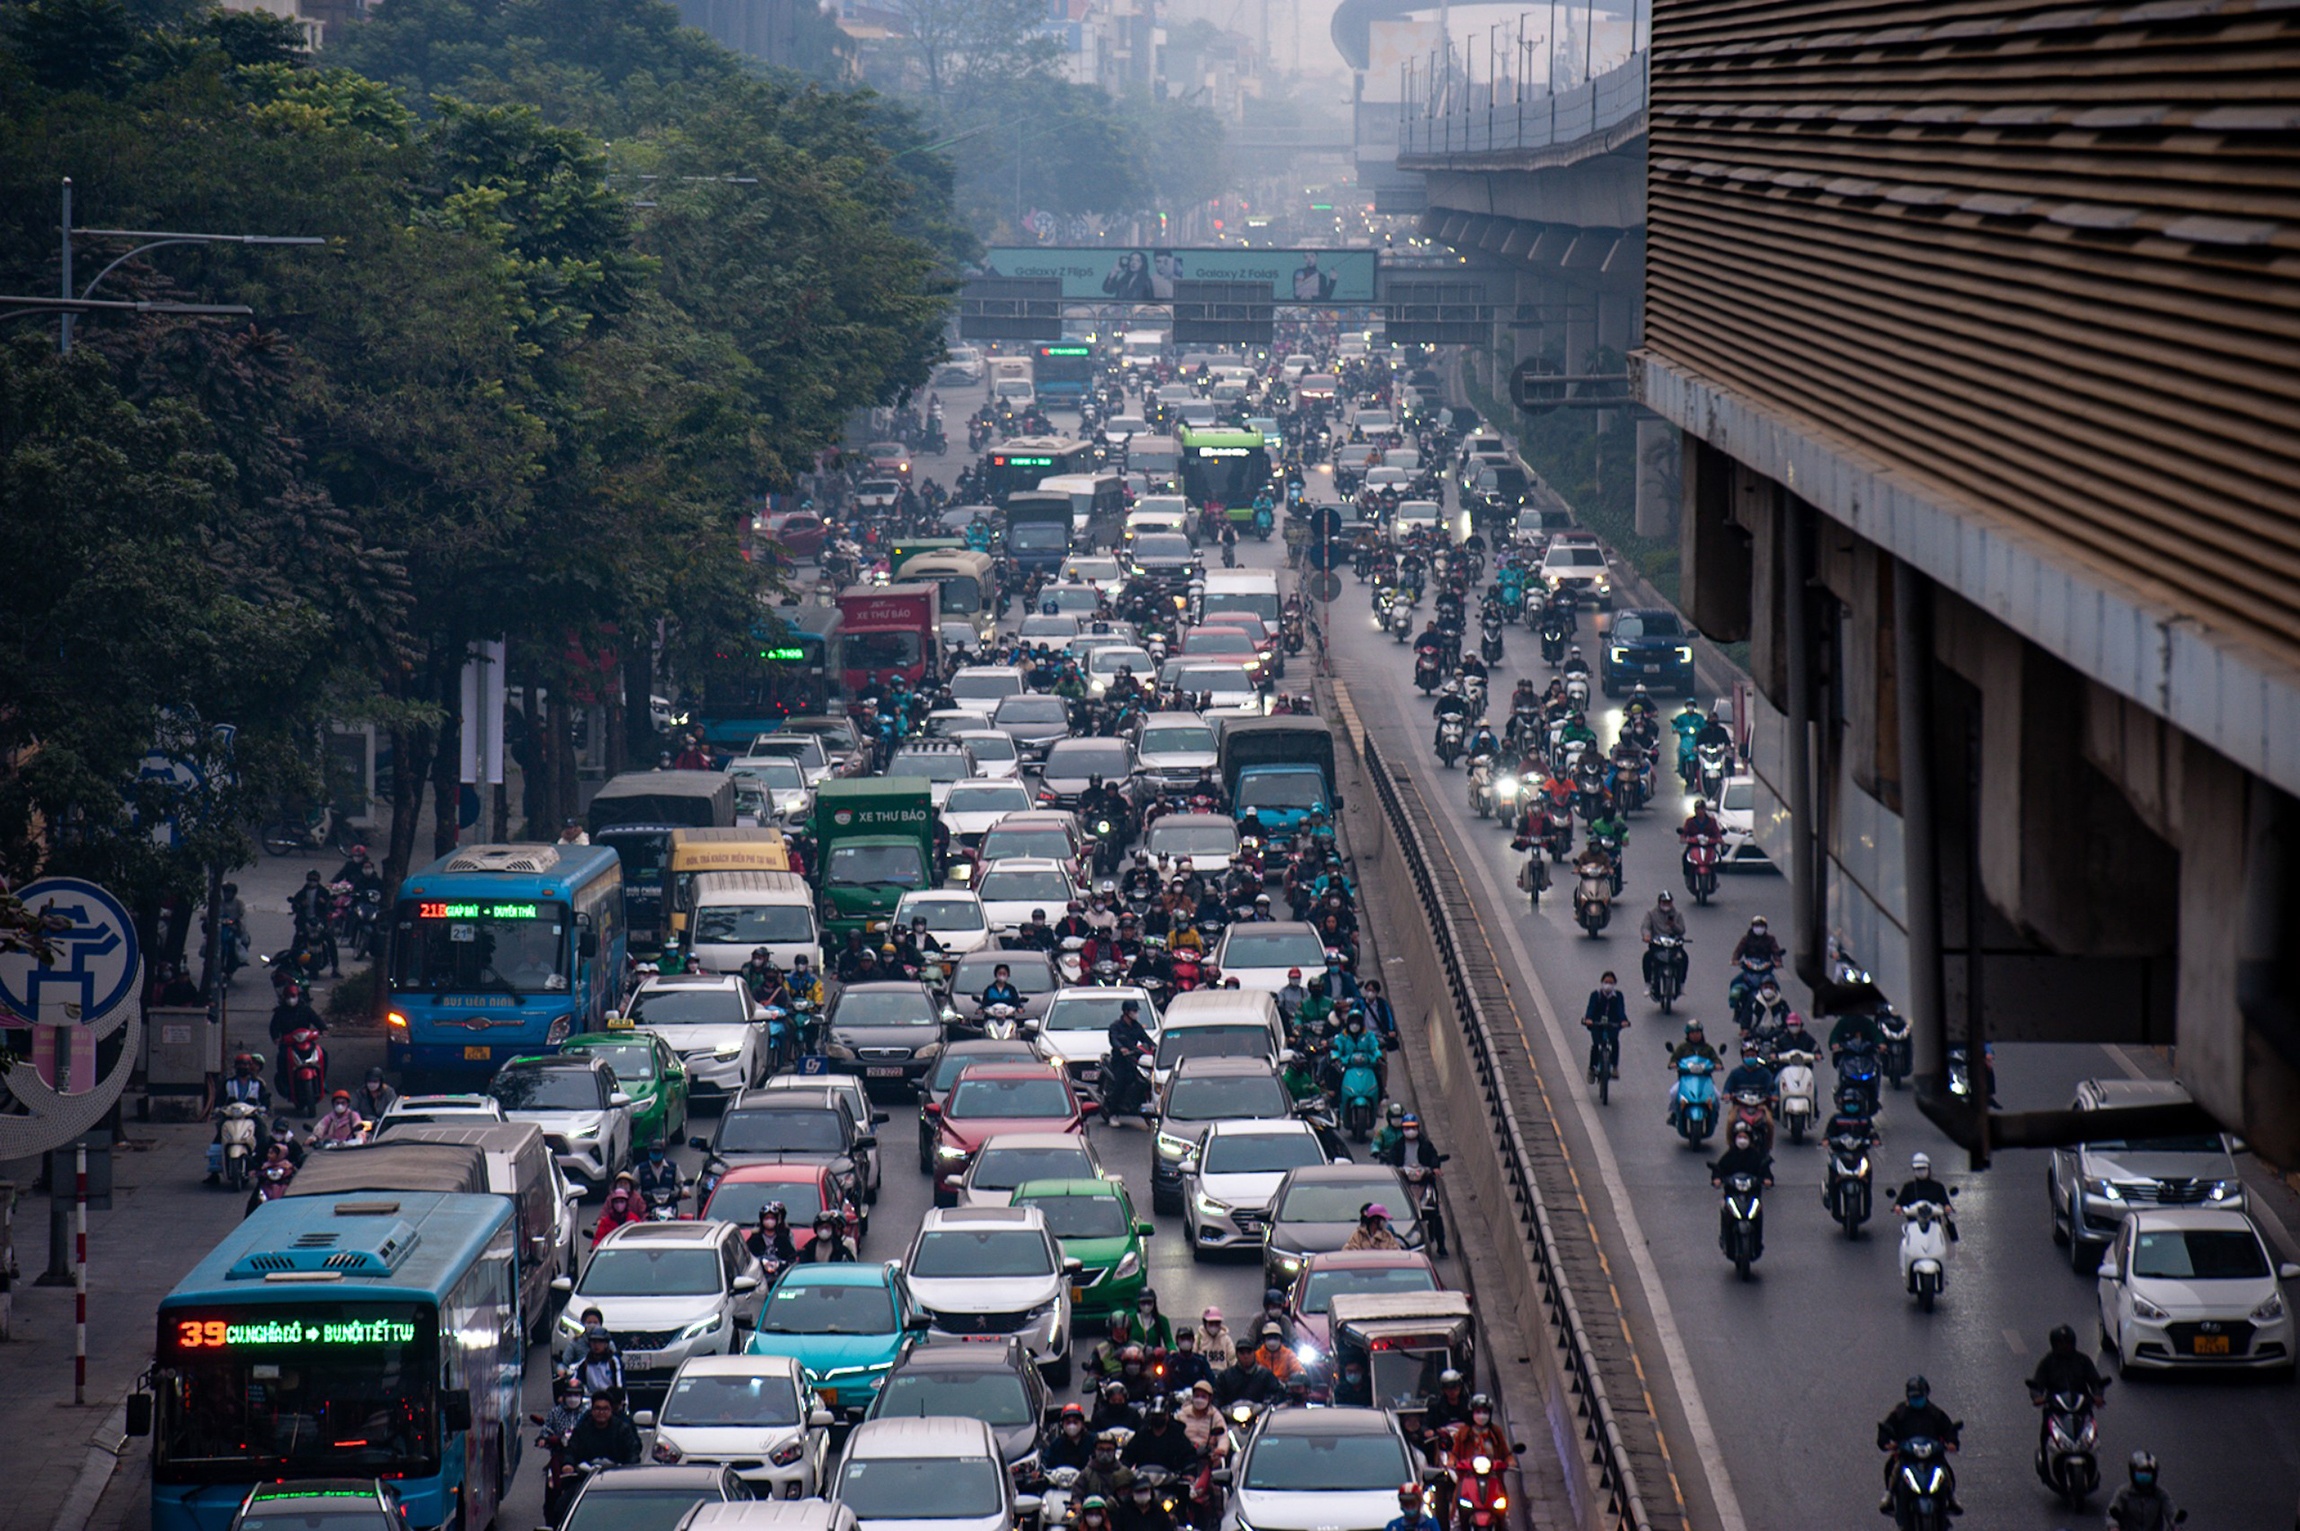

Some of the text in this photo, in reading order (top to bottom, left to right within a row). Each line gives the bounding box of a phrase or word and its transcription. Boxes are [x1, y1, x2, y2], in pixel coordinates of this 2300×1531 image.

[1015, 267, 1094, 278] Galaxy Z Flip5
[1195, 269, 1237, 280] Galaxy
[1240, 270, 1246, 278] Z
[857, 612, 869, 620] XE
[891, 607, 911, 618] BÁO
[859, 807, 927, 823] XE THƯ BÁO
[180, 1320, 226, 1347] 39
